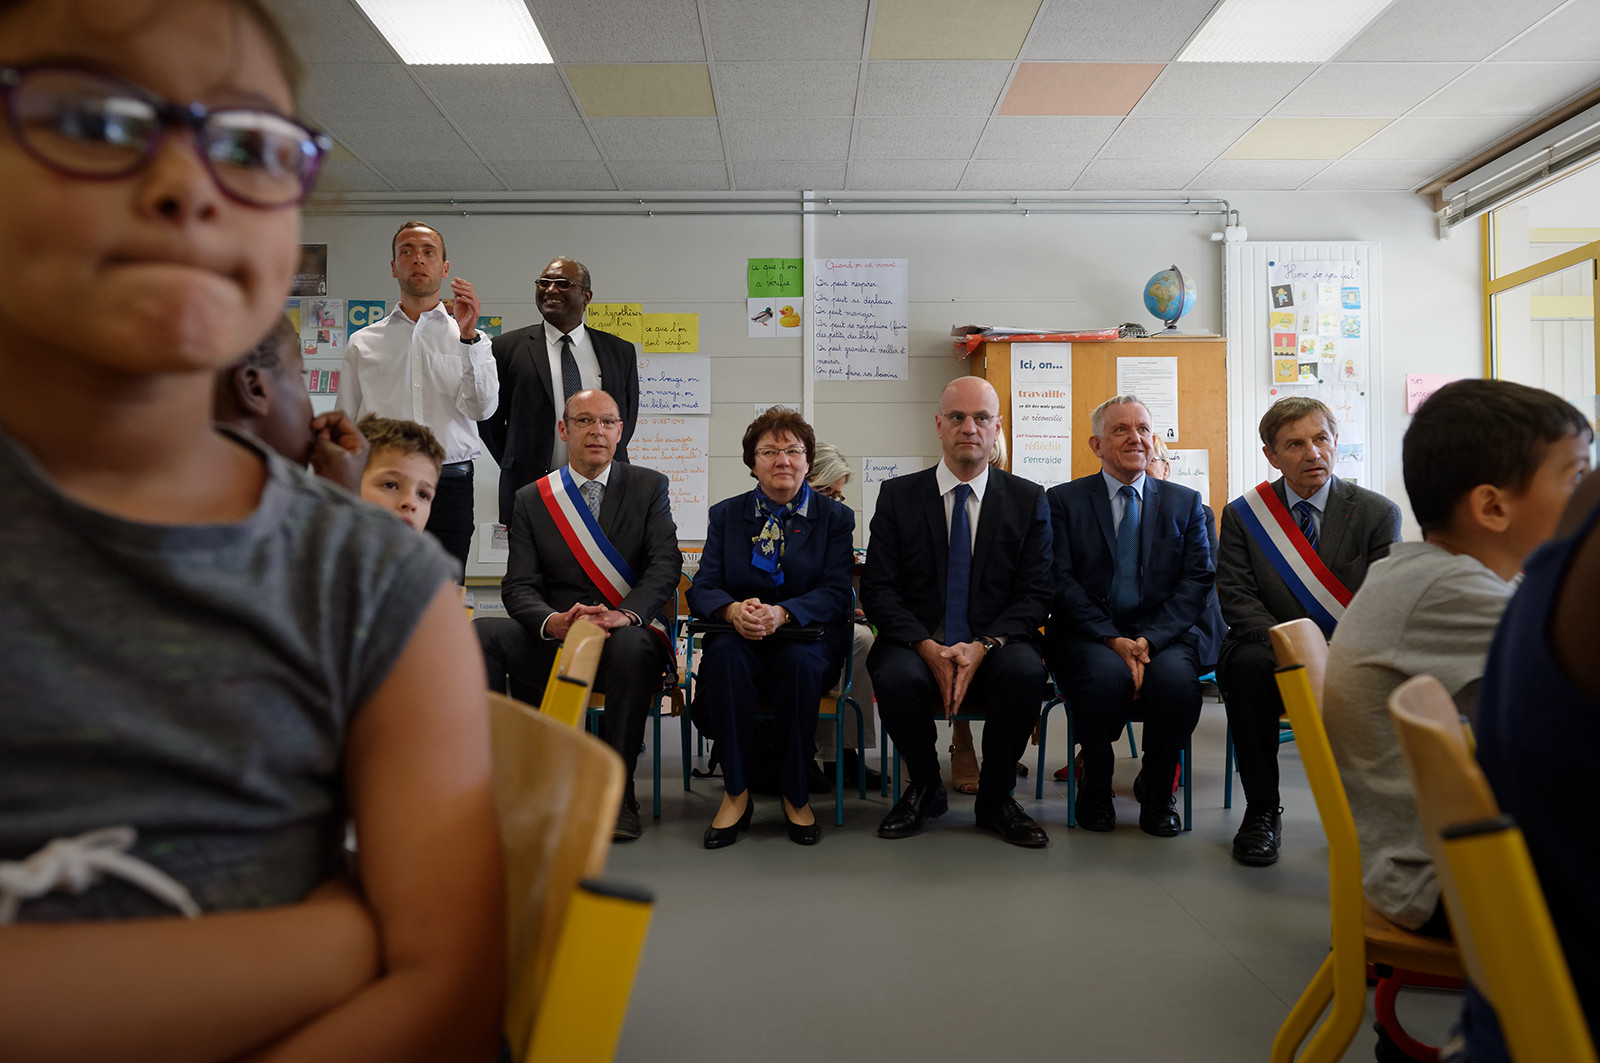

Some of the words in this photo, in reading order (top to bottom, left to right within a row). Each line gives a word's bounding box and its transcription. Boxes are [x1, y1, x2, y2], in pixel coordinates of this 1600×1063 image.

[763, 264, 776, 277] que
[825, 259, 854, 273] Quand
[1284, 263, 1309, 280] How
[1312, 269, 1323, 279] do
[815, 275, 829, 287] On
[830, 280, 848, 293] peut
[814, 290, 829, 301] On
[830, 295, 848, 308] peut
[349, 305, 385, 326] CP
[588, 307, 600, 318] Nos
[814, 304, 827, 315] On
[827, 308, 842, 320] peut
[597, 321, 613, 332] que
[815, 318, 828, 328] On
[829, 321, 846, 332] peut
[645, 325, 653, 333] ce
[655, 326, 668, 339] que
[816, 329, 827, 339] des
[847, 332, 857, 340] des
[645, 338, 660, 348] doit
[815, 343, 827, 352] On
[828, 344, 842, 357] peut
[869, 346, 877, 354] et
[1019, 360, 1036, 370] Ici,
[815, 365, 827, 375] On
[828, 367, 843, 378] peut
[845, 364, 861, 381] faire
[1018, 390, 1066, 399] travaille
[651, 417, 686, 425] QUESTIONS
[1024, 441, 1061, 450] réfléchit
[1023, 456, 1062, 464] s'entraide
[864, 472, 874, 483] la
